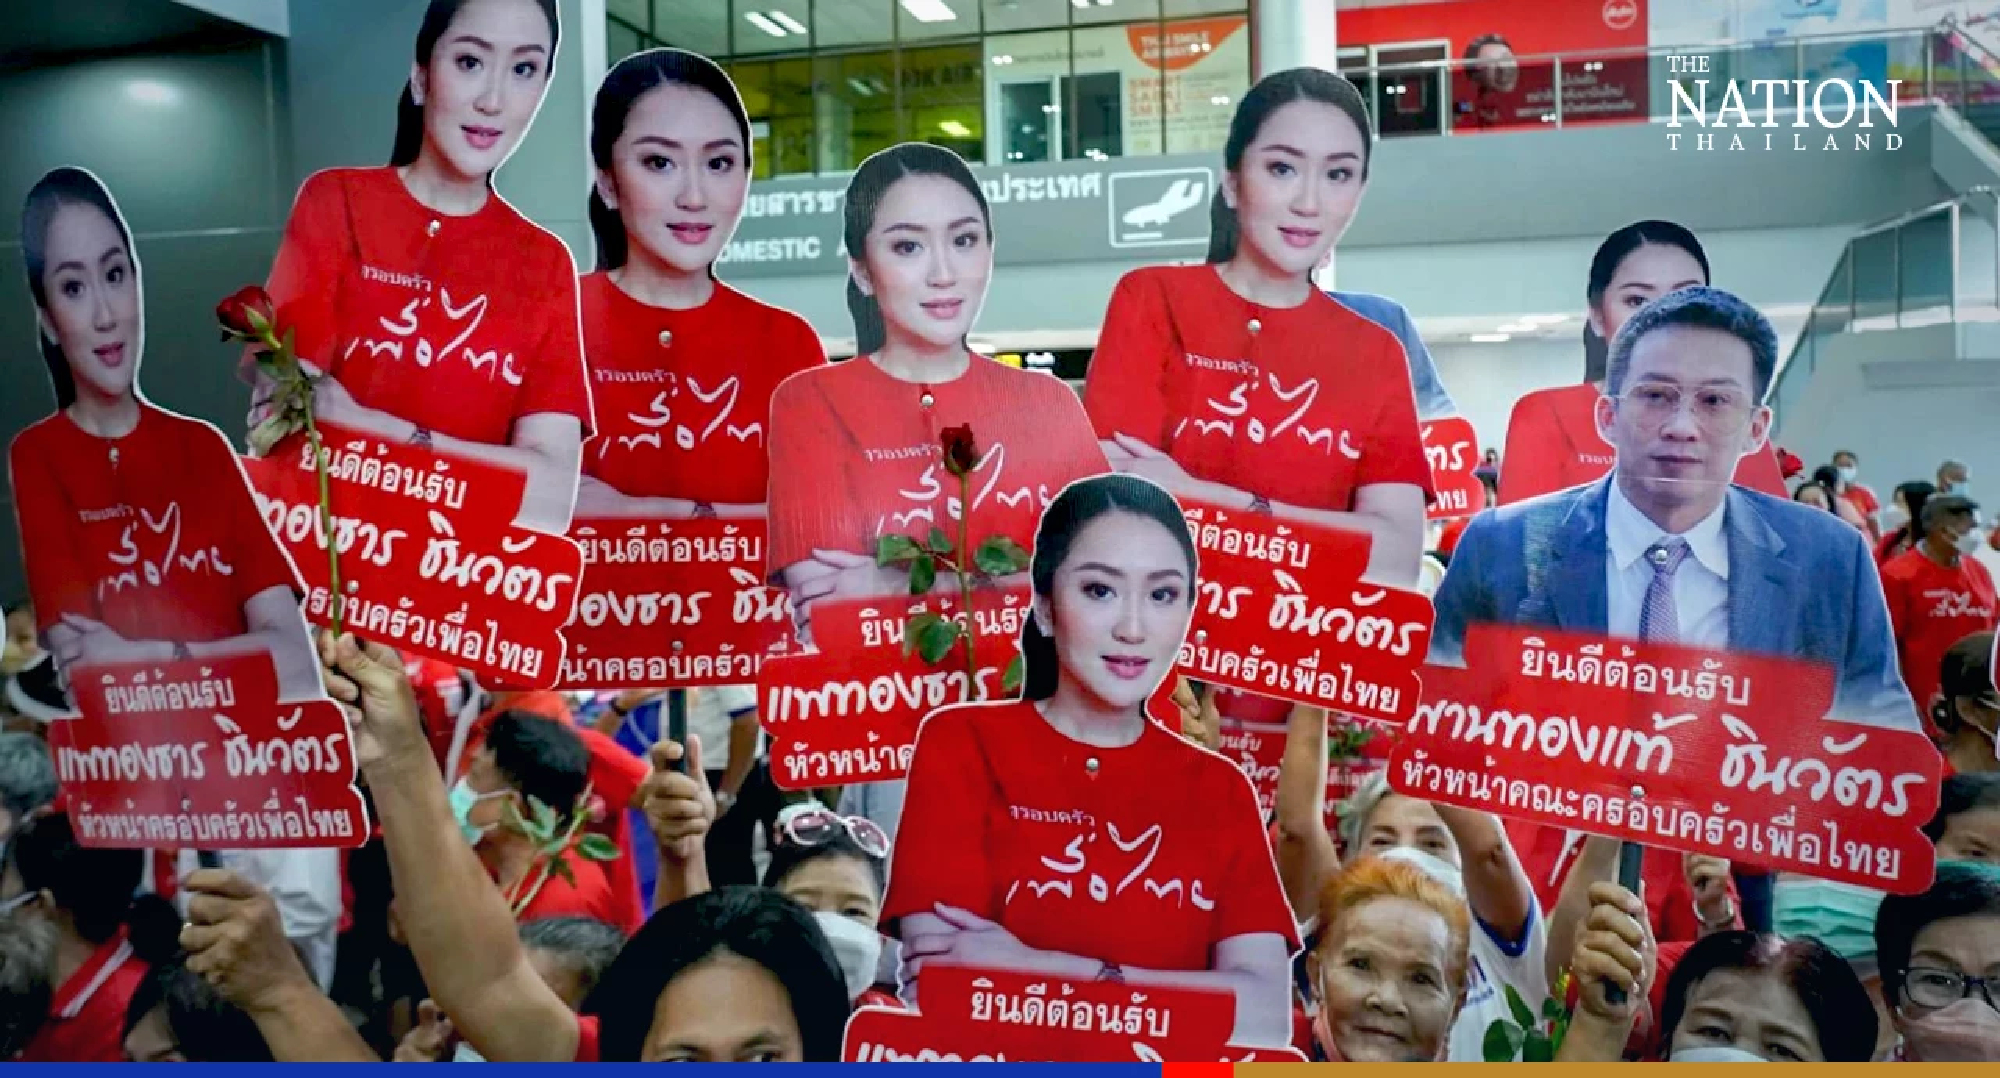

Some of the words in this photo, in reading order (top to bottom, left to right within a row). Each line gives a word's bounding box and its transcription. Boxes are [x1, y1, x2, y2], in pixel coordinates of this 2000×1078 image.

[419, 509, 574, 612] ชินวัตร
[576, 522, 762, 564] ยินดีต้อนรับ
[1268, 568, 1427, 656] ชินวัตร
[102, 665, 235, 714] ยินดีต้อนรับ
[1521, 636, 1750, 707] ยินดีต้อนรับ
[213, 705, 345, 778] ชินวัตร
[1720, 713, 1928, 817] ชินวัตร
[78, 787, 354, 841] หัวหน้าครอบครัวเพื่อไทย
[1402, 749, 1899, 881] หัวหน้าคณะครอบครัวเพื่อไทย
[971, 977, 1171, 1039] ยินดีต้อนรับ
